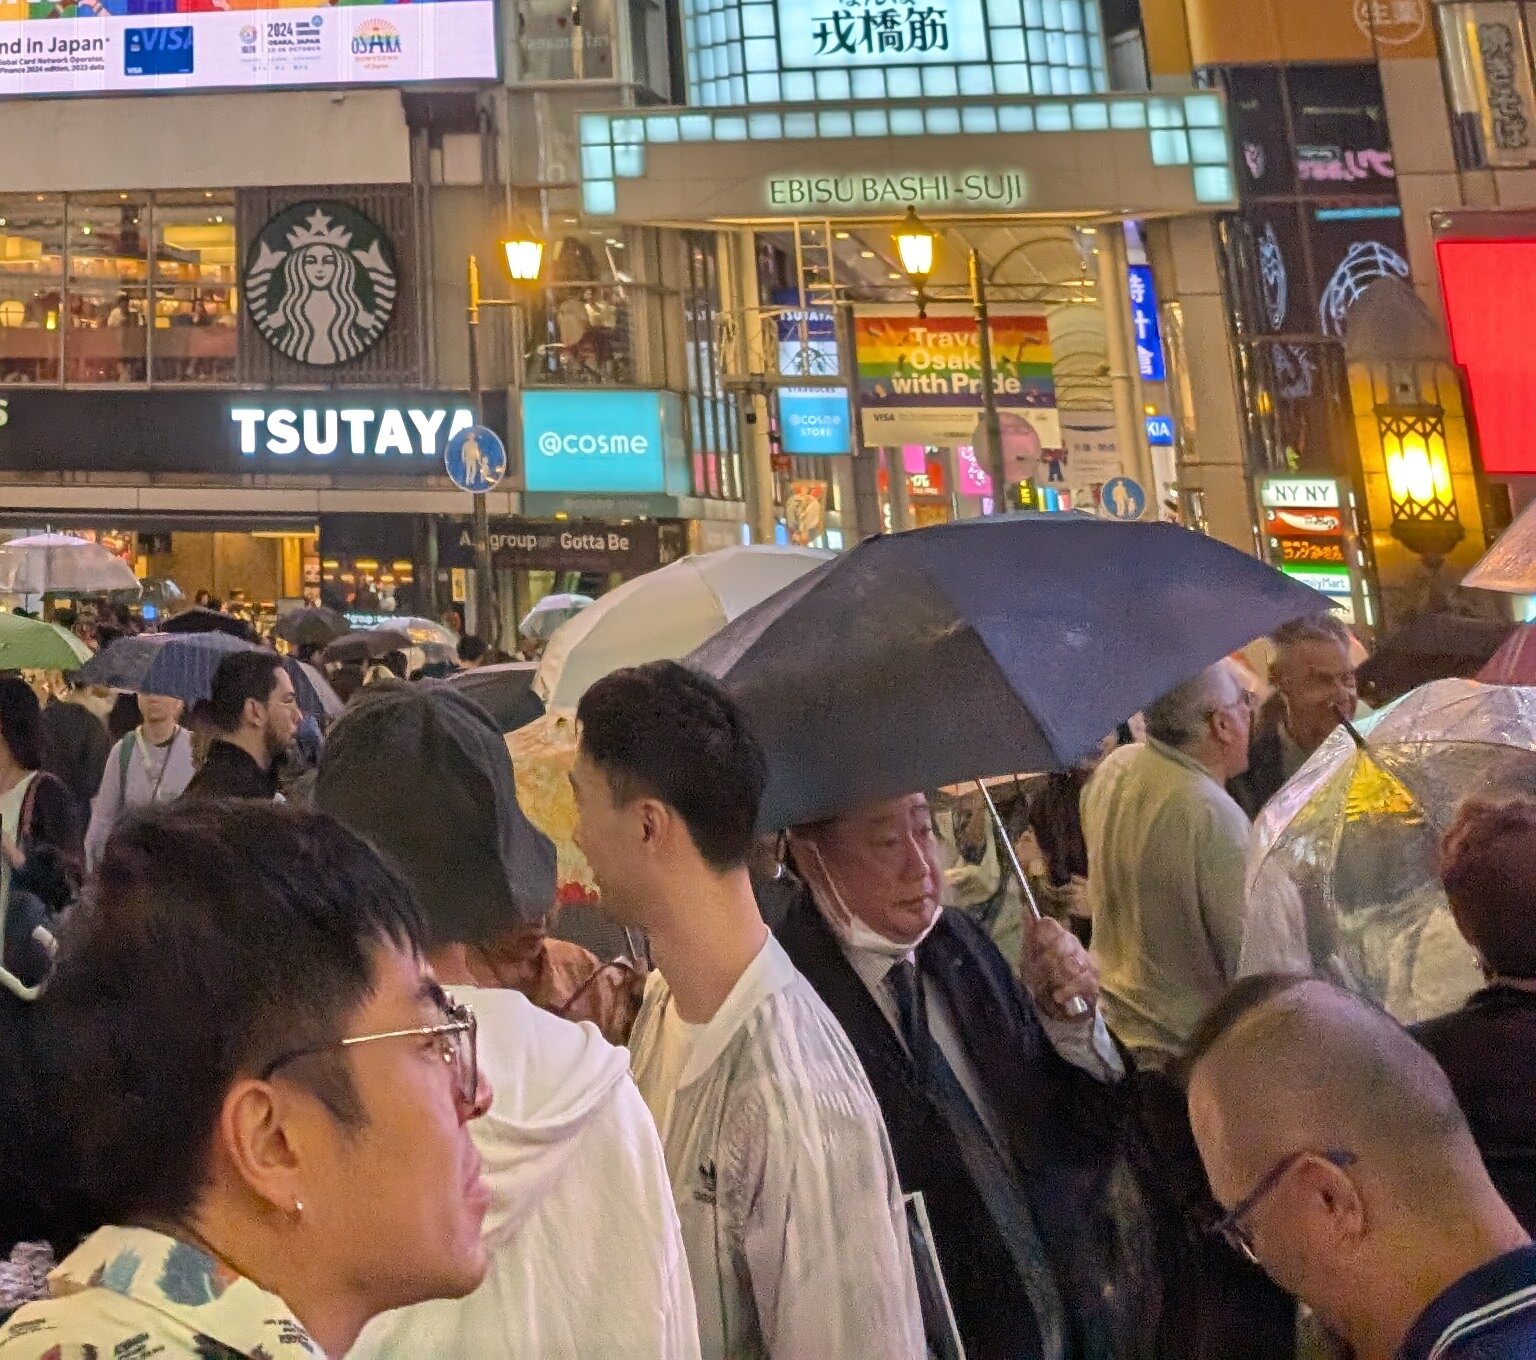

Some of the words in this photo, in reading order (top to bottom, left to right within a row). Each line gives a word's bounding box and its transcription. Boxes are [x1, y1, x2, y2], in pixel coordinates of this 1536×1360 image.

[267, 22, 293, 37] 2024
[811, 6, 950, 56] 戎橋筋
[25, 38, 43, 54] in
[351, 35, 401, 54] OSAKA
[891, 374, 948, 395] with
[952, 374, 1021, 395] Prde
[538, 430, 649, 457] @cosme
[1275, 486, 1298, 501] NY
[1306, 486, 1329, 501] NY
[490, 534, 538, 551] group
[560, 532, 605, 551] Gotta
[608, 533, 630, 551] Be
[1271, 538, 1277, 547] 2
